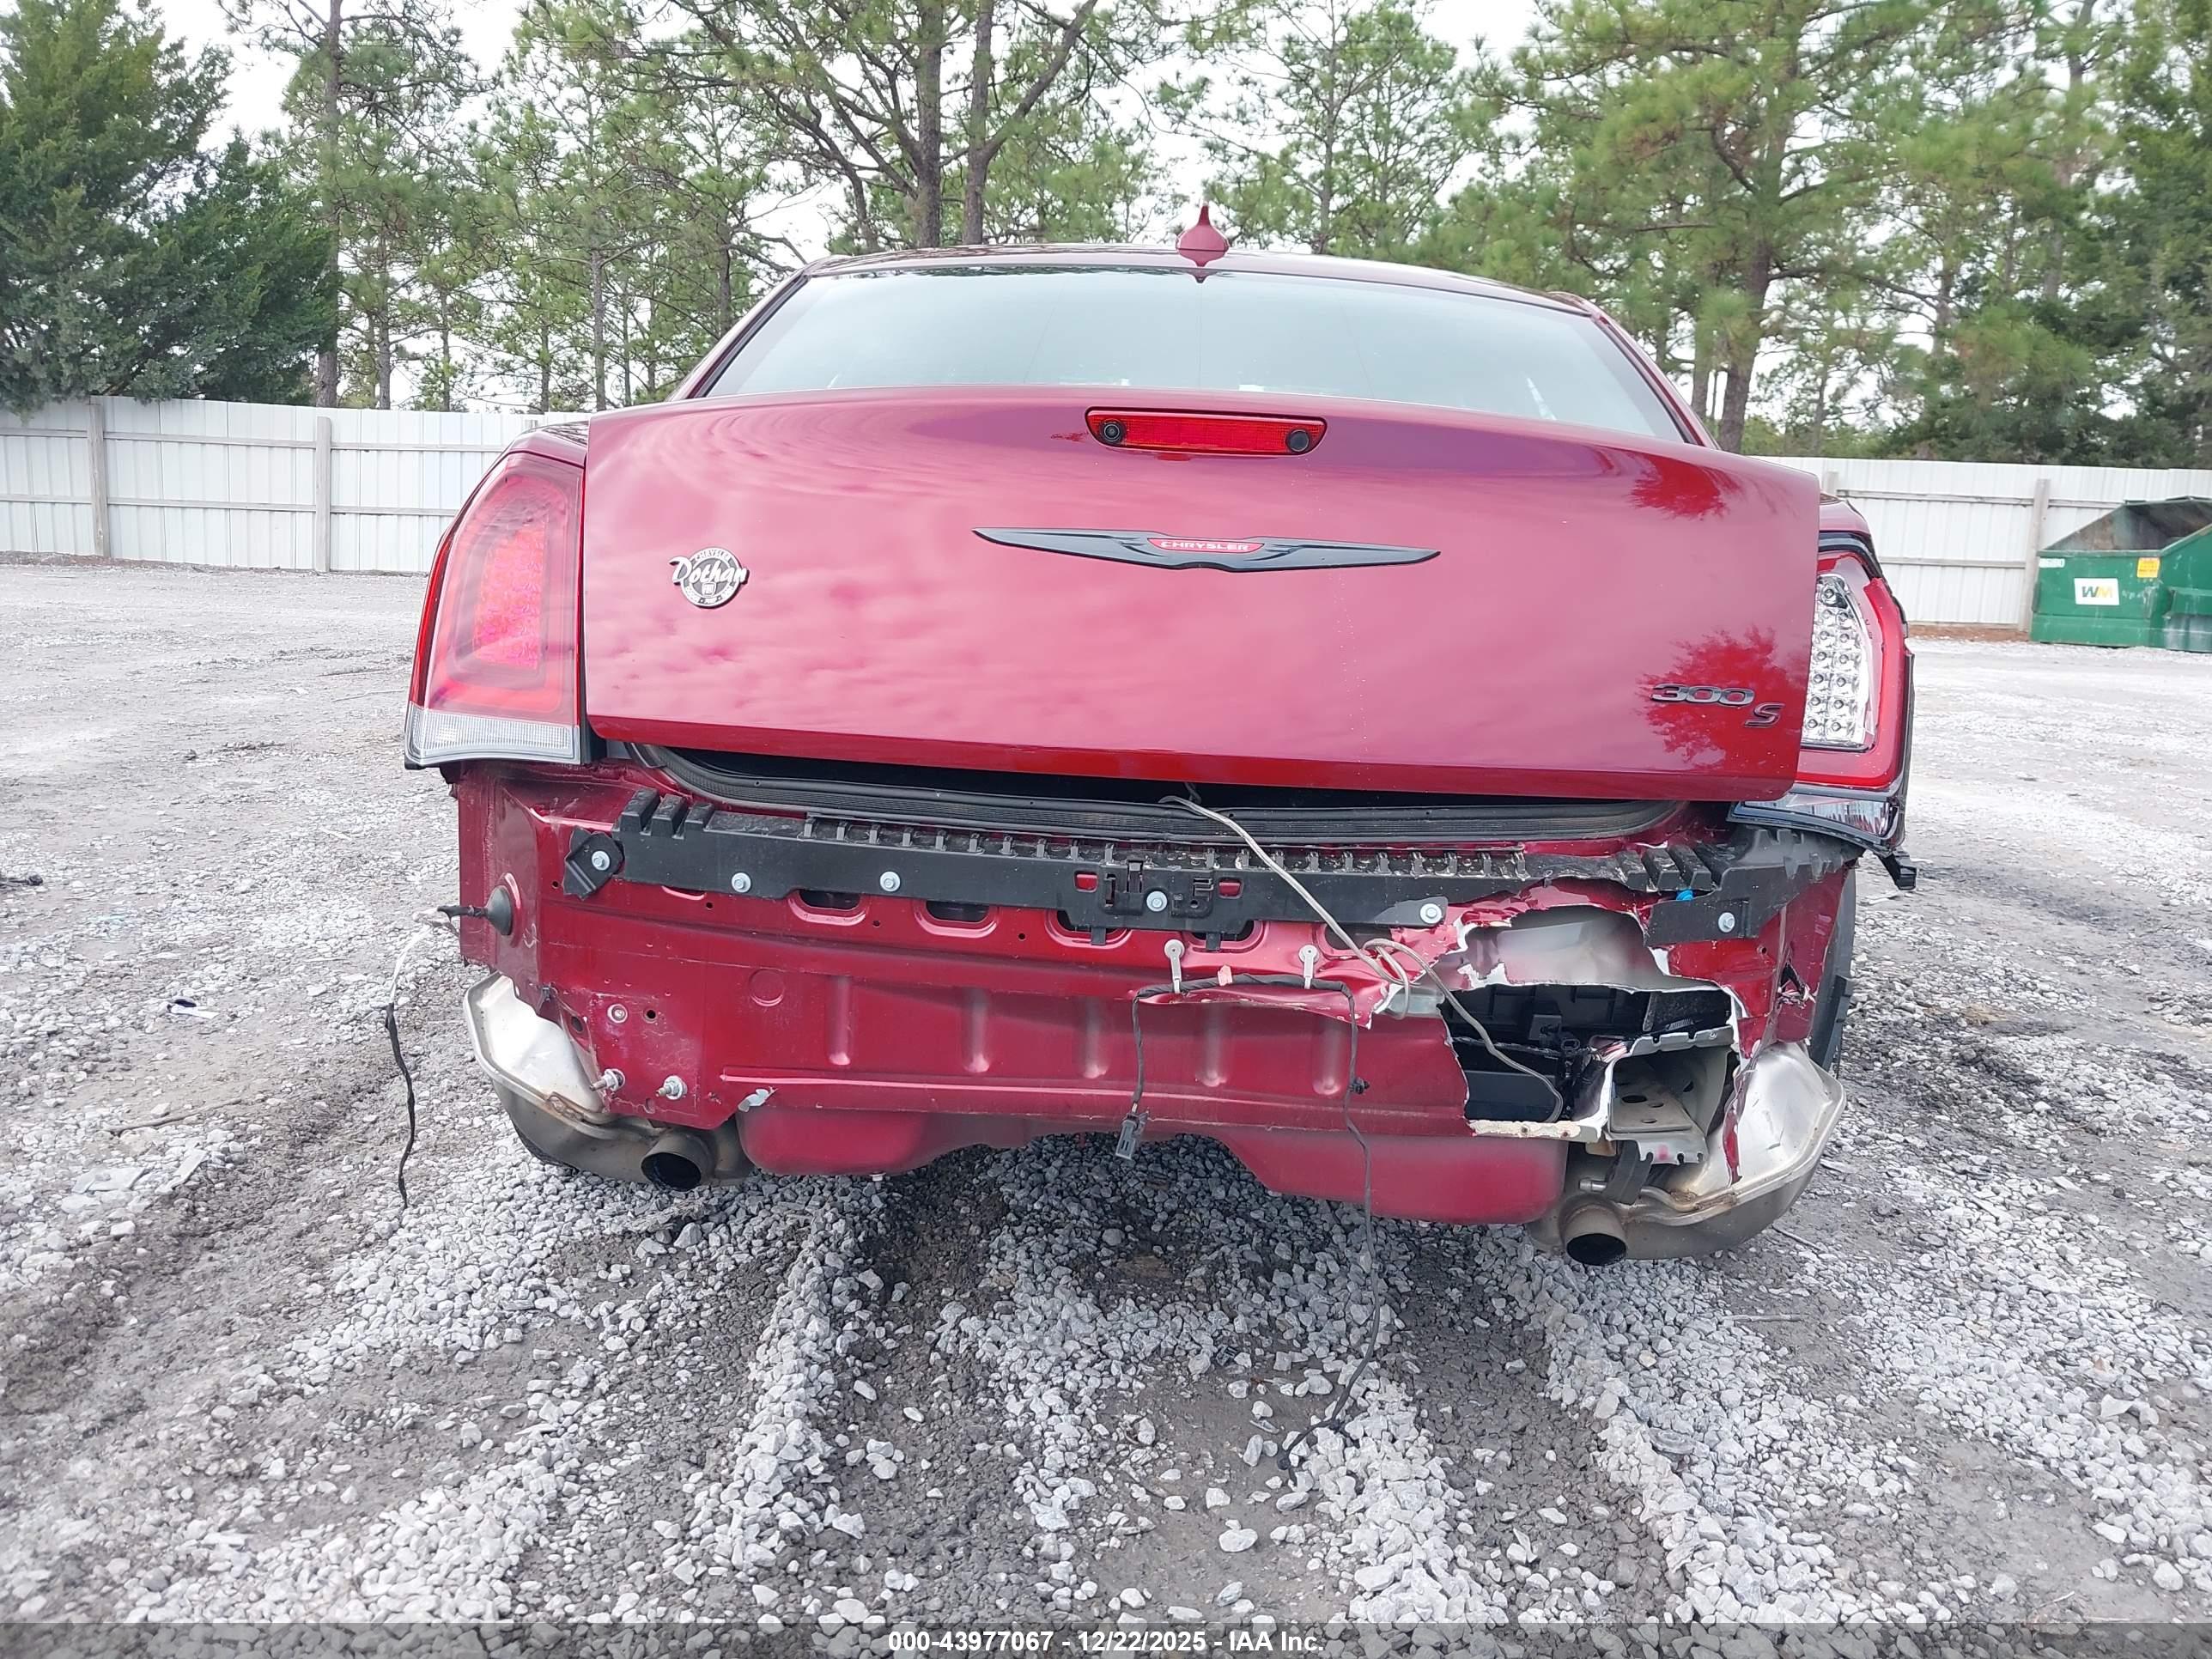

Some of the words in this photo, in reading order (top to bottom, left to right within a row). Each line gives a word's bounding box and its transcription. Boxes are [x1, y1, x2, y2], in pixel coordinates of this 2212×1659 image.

[1160, 540, 1249, 551] CHRYSLER
[668, 556, 747, 584] Dothan
[2081, 586, 2113, 598] WM
[1650, 684, 1754, 707] 300
[1744, 702, 1785, 727] S
